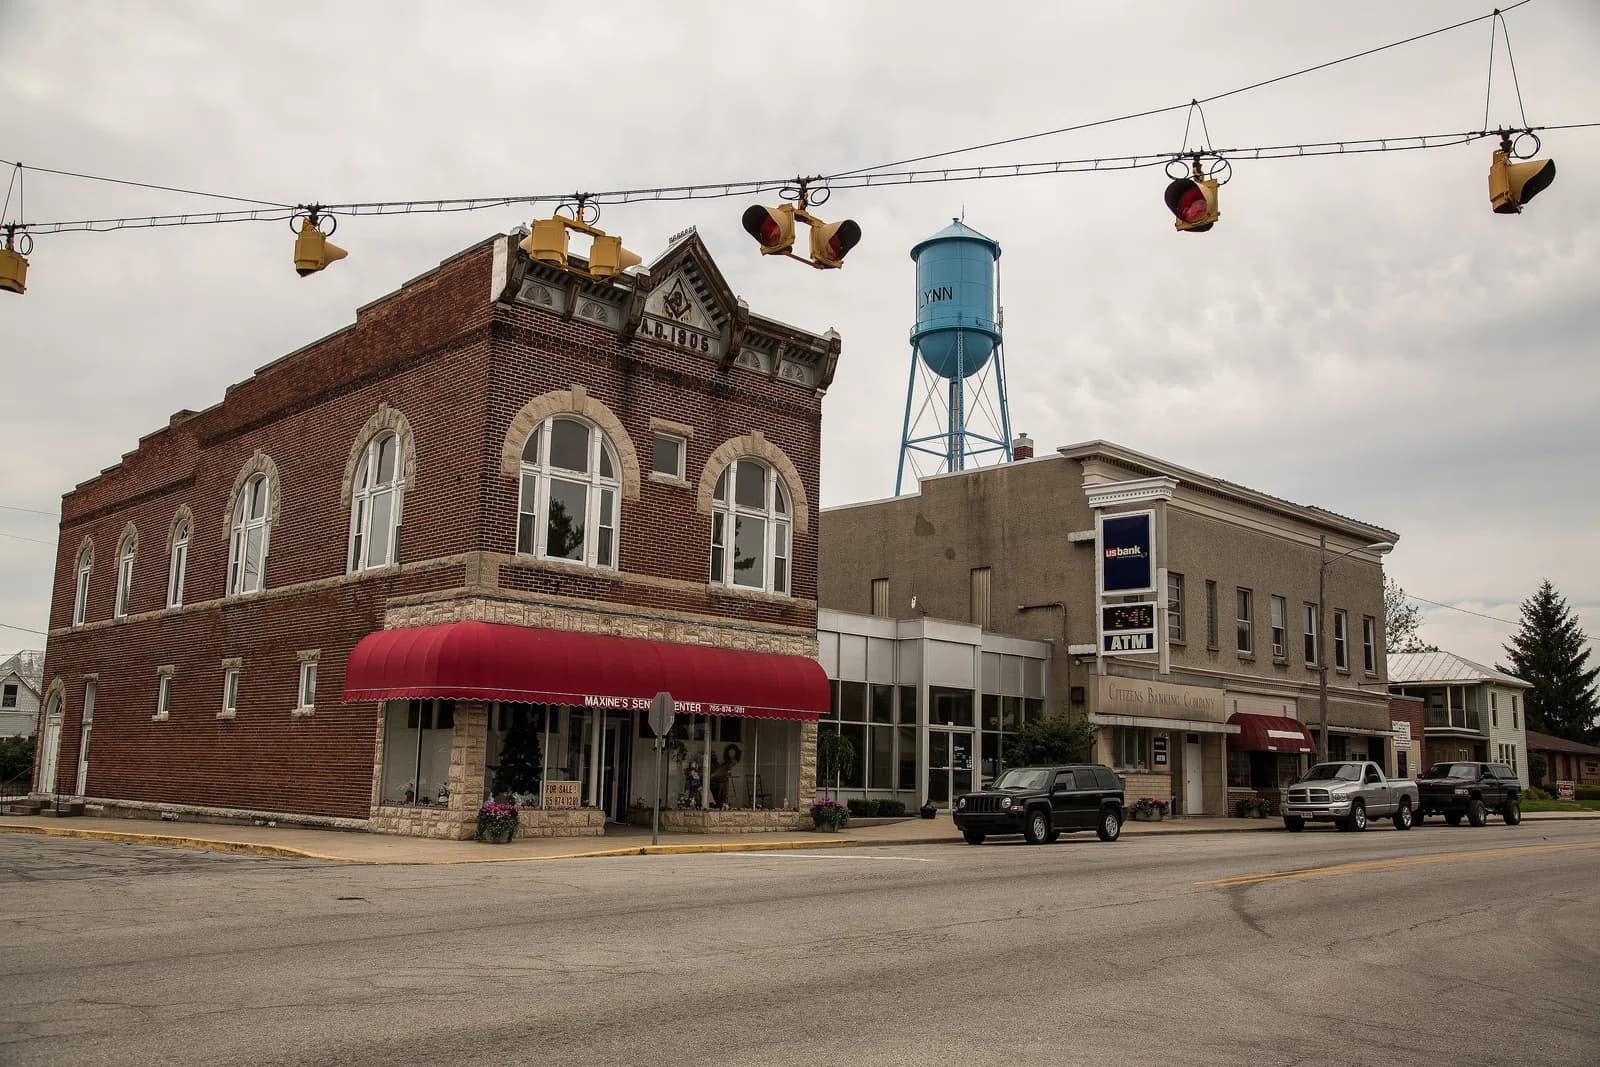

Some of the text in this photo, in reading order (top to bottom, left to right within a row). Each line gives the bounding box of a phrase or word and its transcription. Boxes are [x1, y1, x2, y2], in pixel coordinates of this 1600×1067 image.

[1111, 634, 1147, 651] ATM
[584, 696, 628, 708] MAXINE'S
[674, 702, 702, 713] ENTER
[545, 785, 556, 794] FOR
